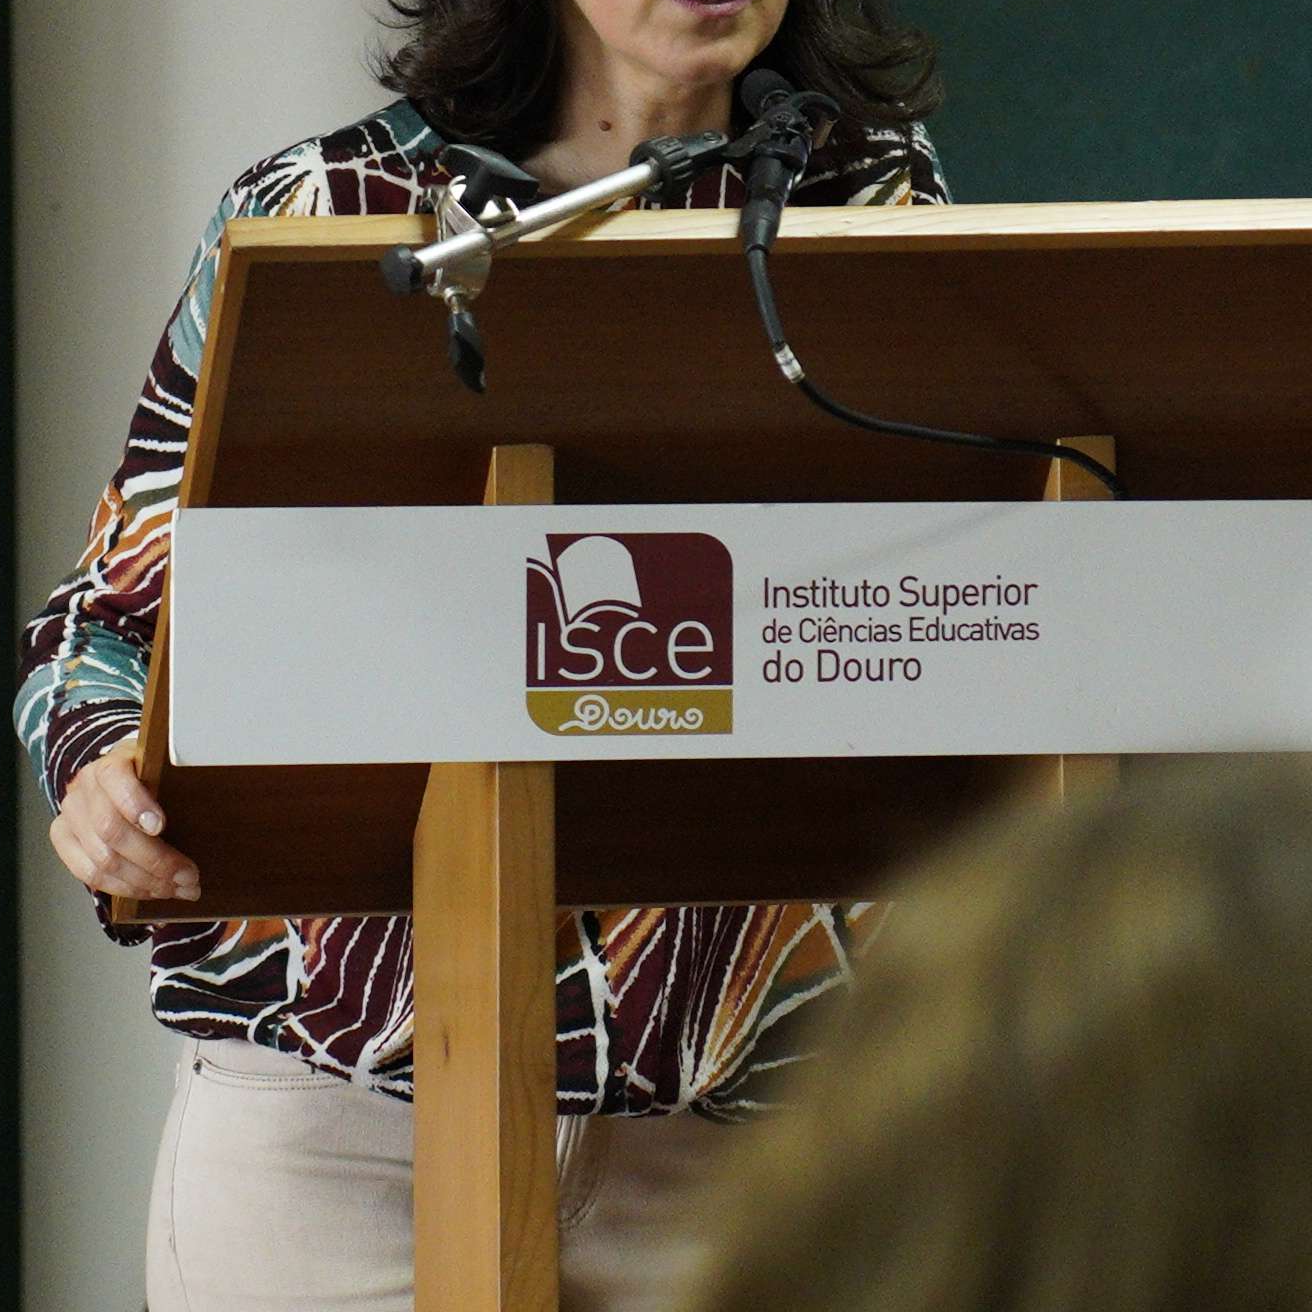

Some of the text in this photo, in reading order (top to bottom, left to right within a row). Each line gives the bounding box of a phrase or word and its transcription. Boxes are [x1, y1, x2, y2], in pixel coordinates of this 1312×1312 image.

[763, 574, 1039, 616] Instituto Superior
[762, 615, 1040, 644] de Ciências Educativas
[762, 649, 923, 683] do Douro
[558, 694, 704, 732] Douro
